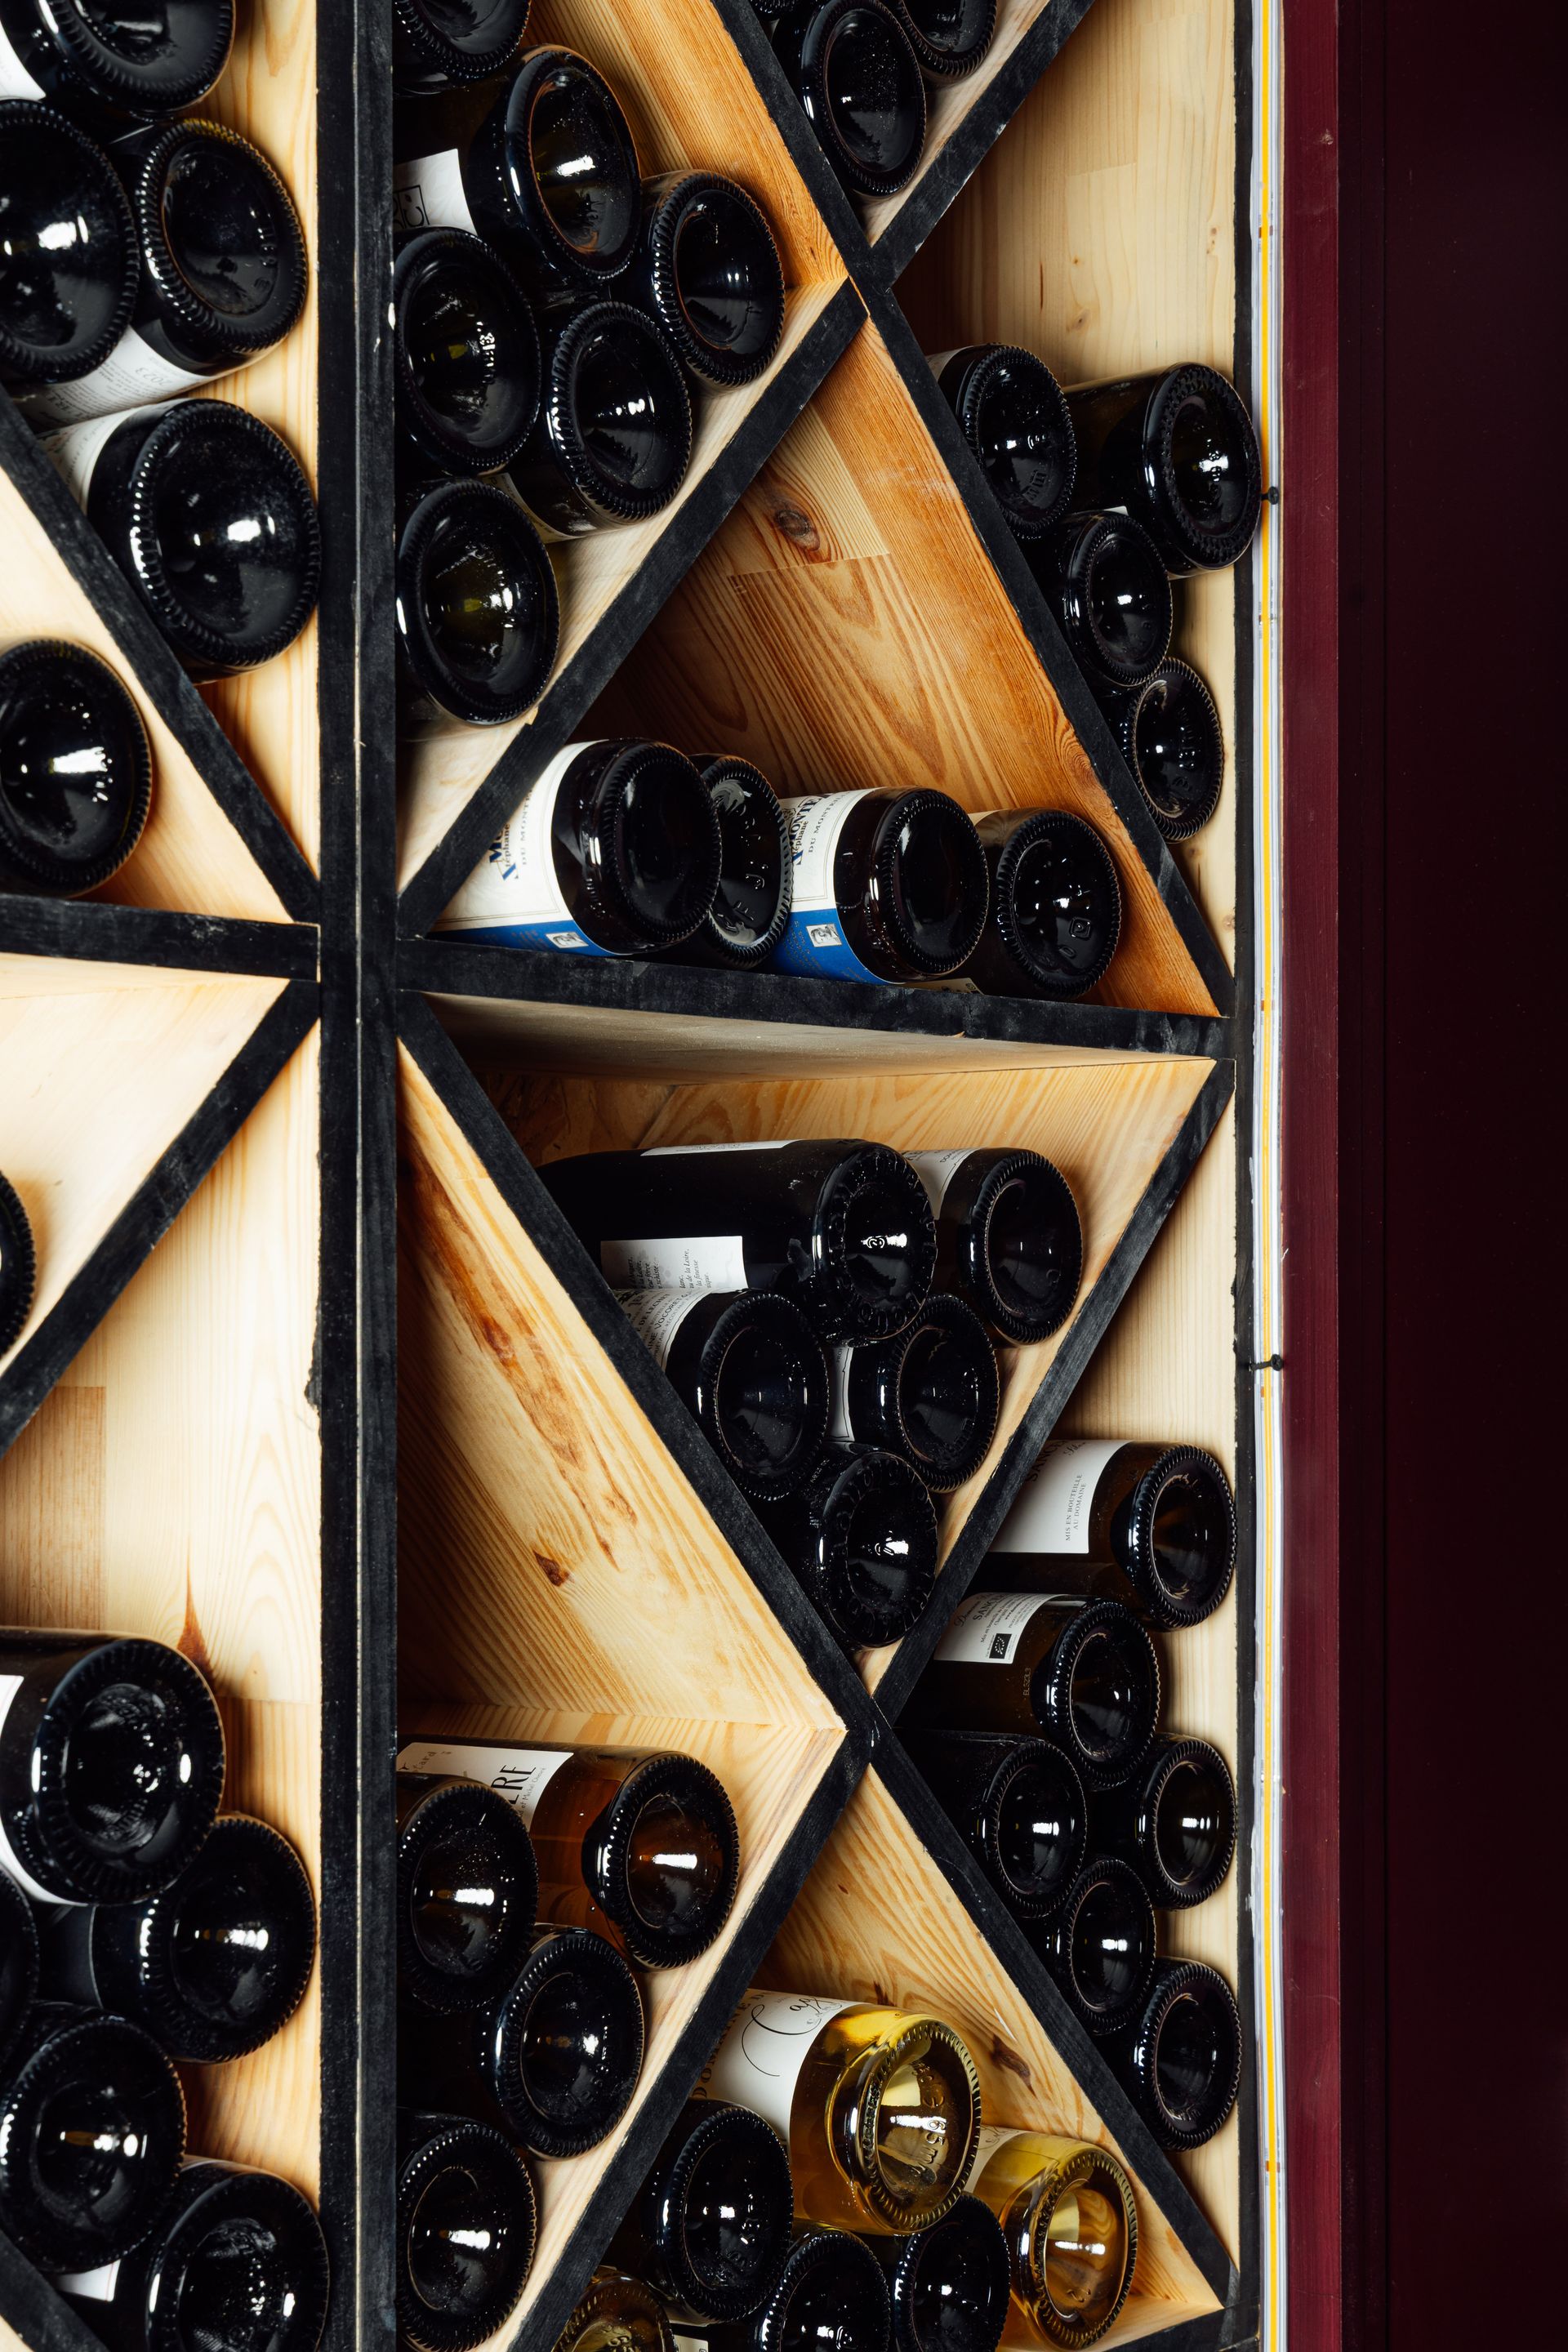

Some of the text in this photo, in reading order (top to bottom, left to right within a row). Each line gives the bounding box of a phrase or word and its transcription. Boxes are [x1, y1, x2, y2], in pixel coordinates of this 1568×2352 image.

[1067, 1474, 1082, 1512] BOUTEILLE
[1073, 1483, 1086, 1530] AU DOMAINE
[1066, 1515, 1071, 1525] EN
